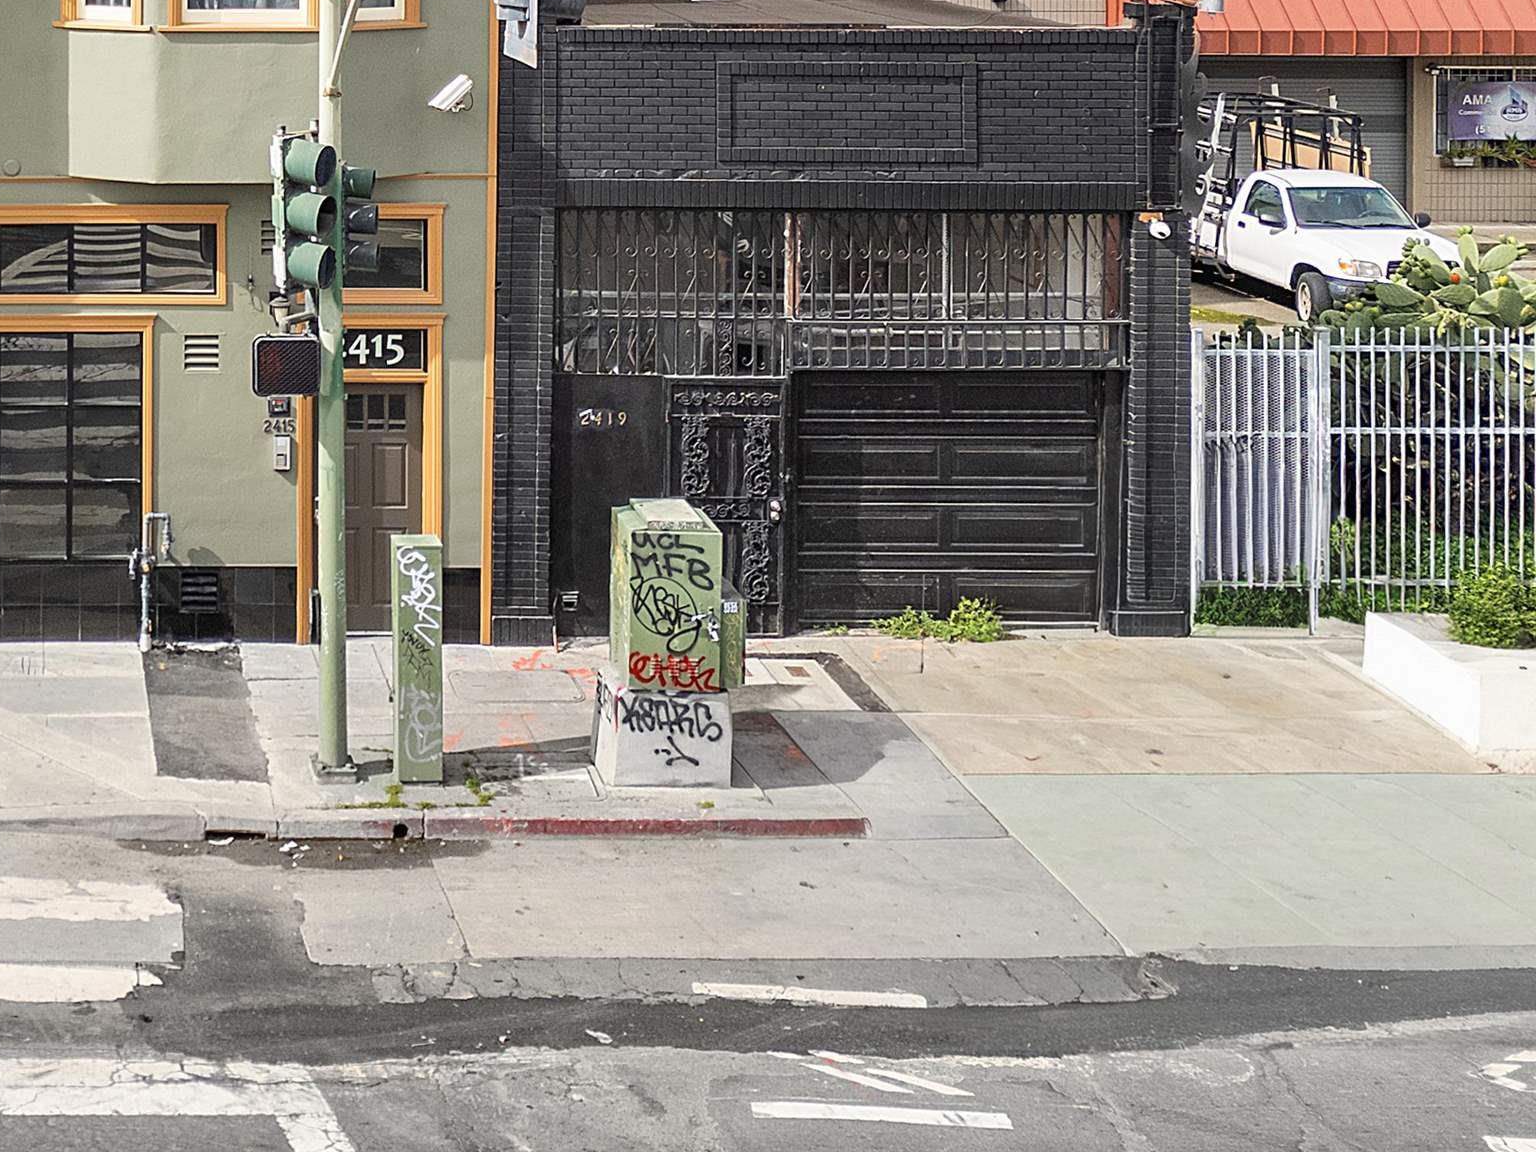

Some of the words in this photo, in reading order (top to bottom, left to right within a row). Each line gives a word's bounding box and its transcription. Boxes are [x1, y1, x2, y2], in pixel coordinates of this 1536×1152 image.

[342, 334, 405, 366] 415
[264, 419, 296, 433] 2415
[579, 409, 627, 426] 2419
